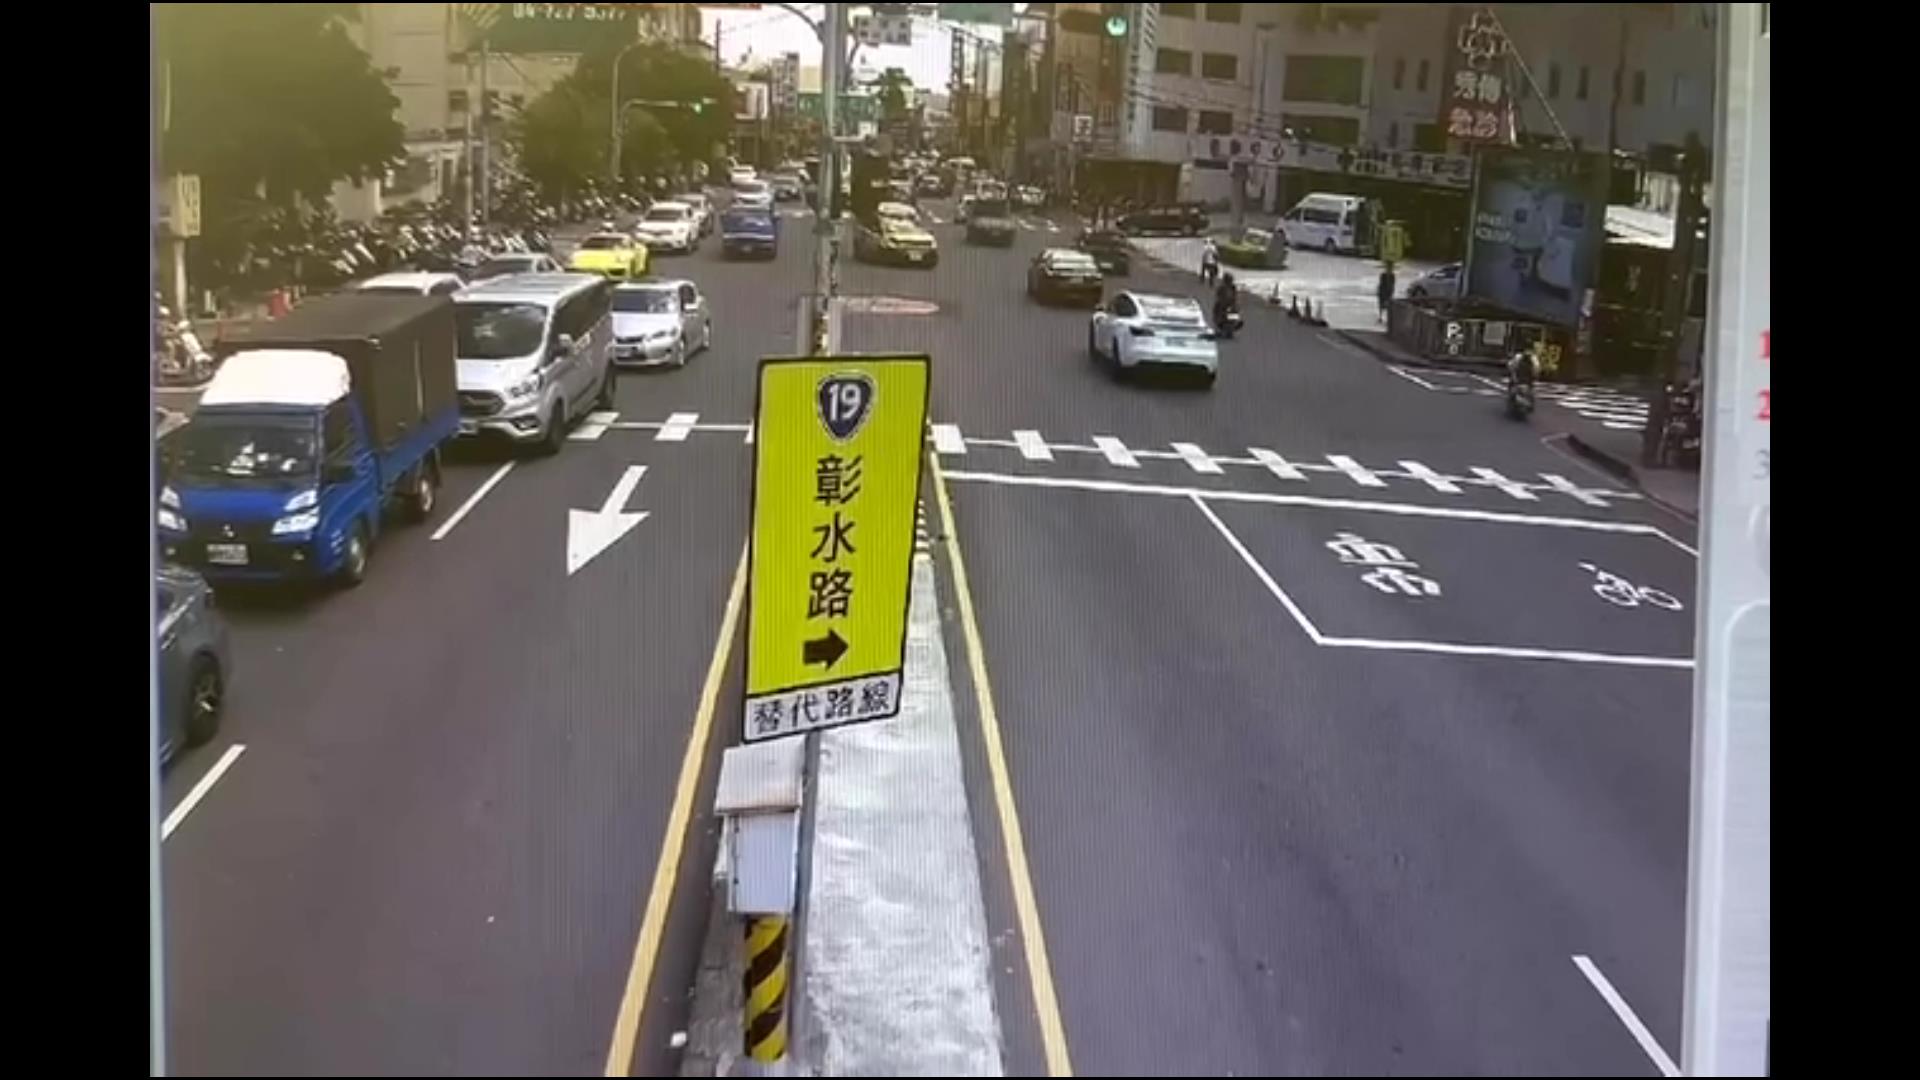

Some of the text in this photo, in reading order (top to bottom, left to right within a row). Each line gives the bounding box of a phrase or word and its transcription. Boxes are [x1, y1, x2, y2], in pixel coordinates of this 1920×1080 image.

[826, 383, 862, 424] 19
[807, 452, 863, 620] 彰水路
[753, 681, 890, 735] 替代路線
